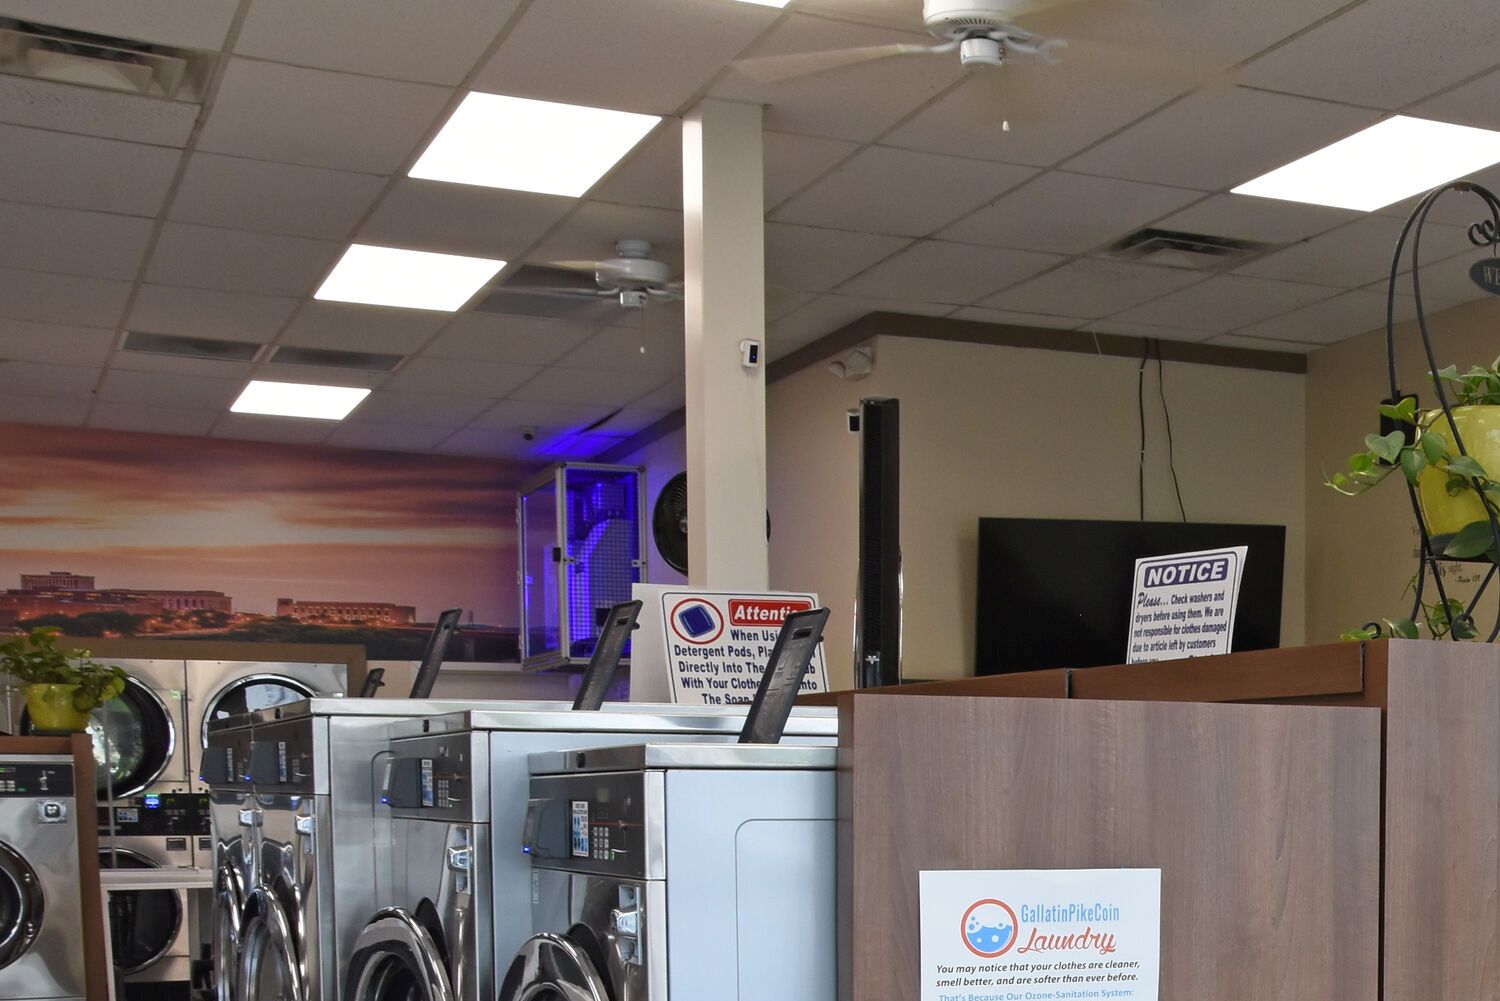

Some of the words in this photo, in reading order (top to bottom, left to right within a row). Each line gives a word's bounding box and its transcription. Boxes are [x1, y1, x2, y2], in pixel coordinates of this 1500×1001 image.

[1147, 561, 1225, 586] NOTICE
[1171, 594, 1187, 604] Check
[1190, 592, 1212, 603] washers
[1214, 590, 1224, 600] and
[1136, 613, 1152, 624] dryers
[1153, 611, 1170, 621] before
[1172, 610, 1186, 621] using
[1187, 608, 1202, 618] them.
[1205, 607, 1213, 617] We
[1214, 608, 1224, 616] are
[730, 629, 758, 641] When
[1134, 628, 1142, 638] not
[1143, 624, 1172, 638] responsible
[1181, 623, 1200, 634] clothes
[1202, 621, 1227, 634] damaged
[674, 645, 725, 659] Detergent
[728, 646, 755, 659] Pods,
[1132, 642, 1142, 652] due
[1143, 642, 1149, 652] to
[1150, 640, 1168, 651] article
[1169, 639, 1178, 650] left
[1179, 638, 1185, 652] by
[1187, 639, 1216, 650] customers
[679, 661, 719, 675] Directly
[722, 662, 742, 673] Into
[745, 662, 765, 673] The
[681, 677, 704, 688] With
[706, 678, 728, 689] Your
[731, 678, 760, 689] Clothe
[702, 694, 722, 704] The
[1022, 903, 1120, 923] GallatinPikeCoin
[1017, 926, 1117, 955] Laundry
[936, 964, 954, 973] You
[955, 966, 977, 974] may
[978, 963, 1007, 972] notice
[1009, 962, 1029, 971] that
[1030, 963, 1052, 973] your
[1053, 961, 1086, 970] clothes
[1104, 959, 1139, 969] cleaner,
[935, 977, 962, 987] smell
[962, 977, 994, 986] better,
[995, 975, 1015, 985] and
[1033, 974, 1061, 984] softer
[1062, 974, 1083, 982] than
[1106, 972, 1138, 981] before.
[967, 993, 1004, 1001] Because
[1006, 992, 1023, 1000] Our
[1024, 990, 1099, 999] Ozone-Sanitation
[1099, 989, 1134, 998] System:
